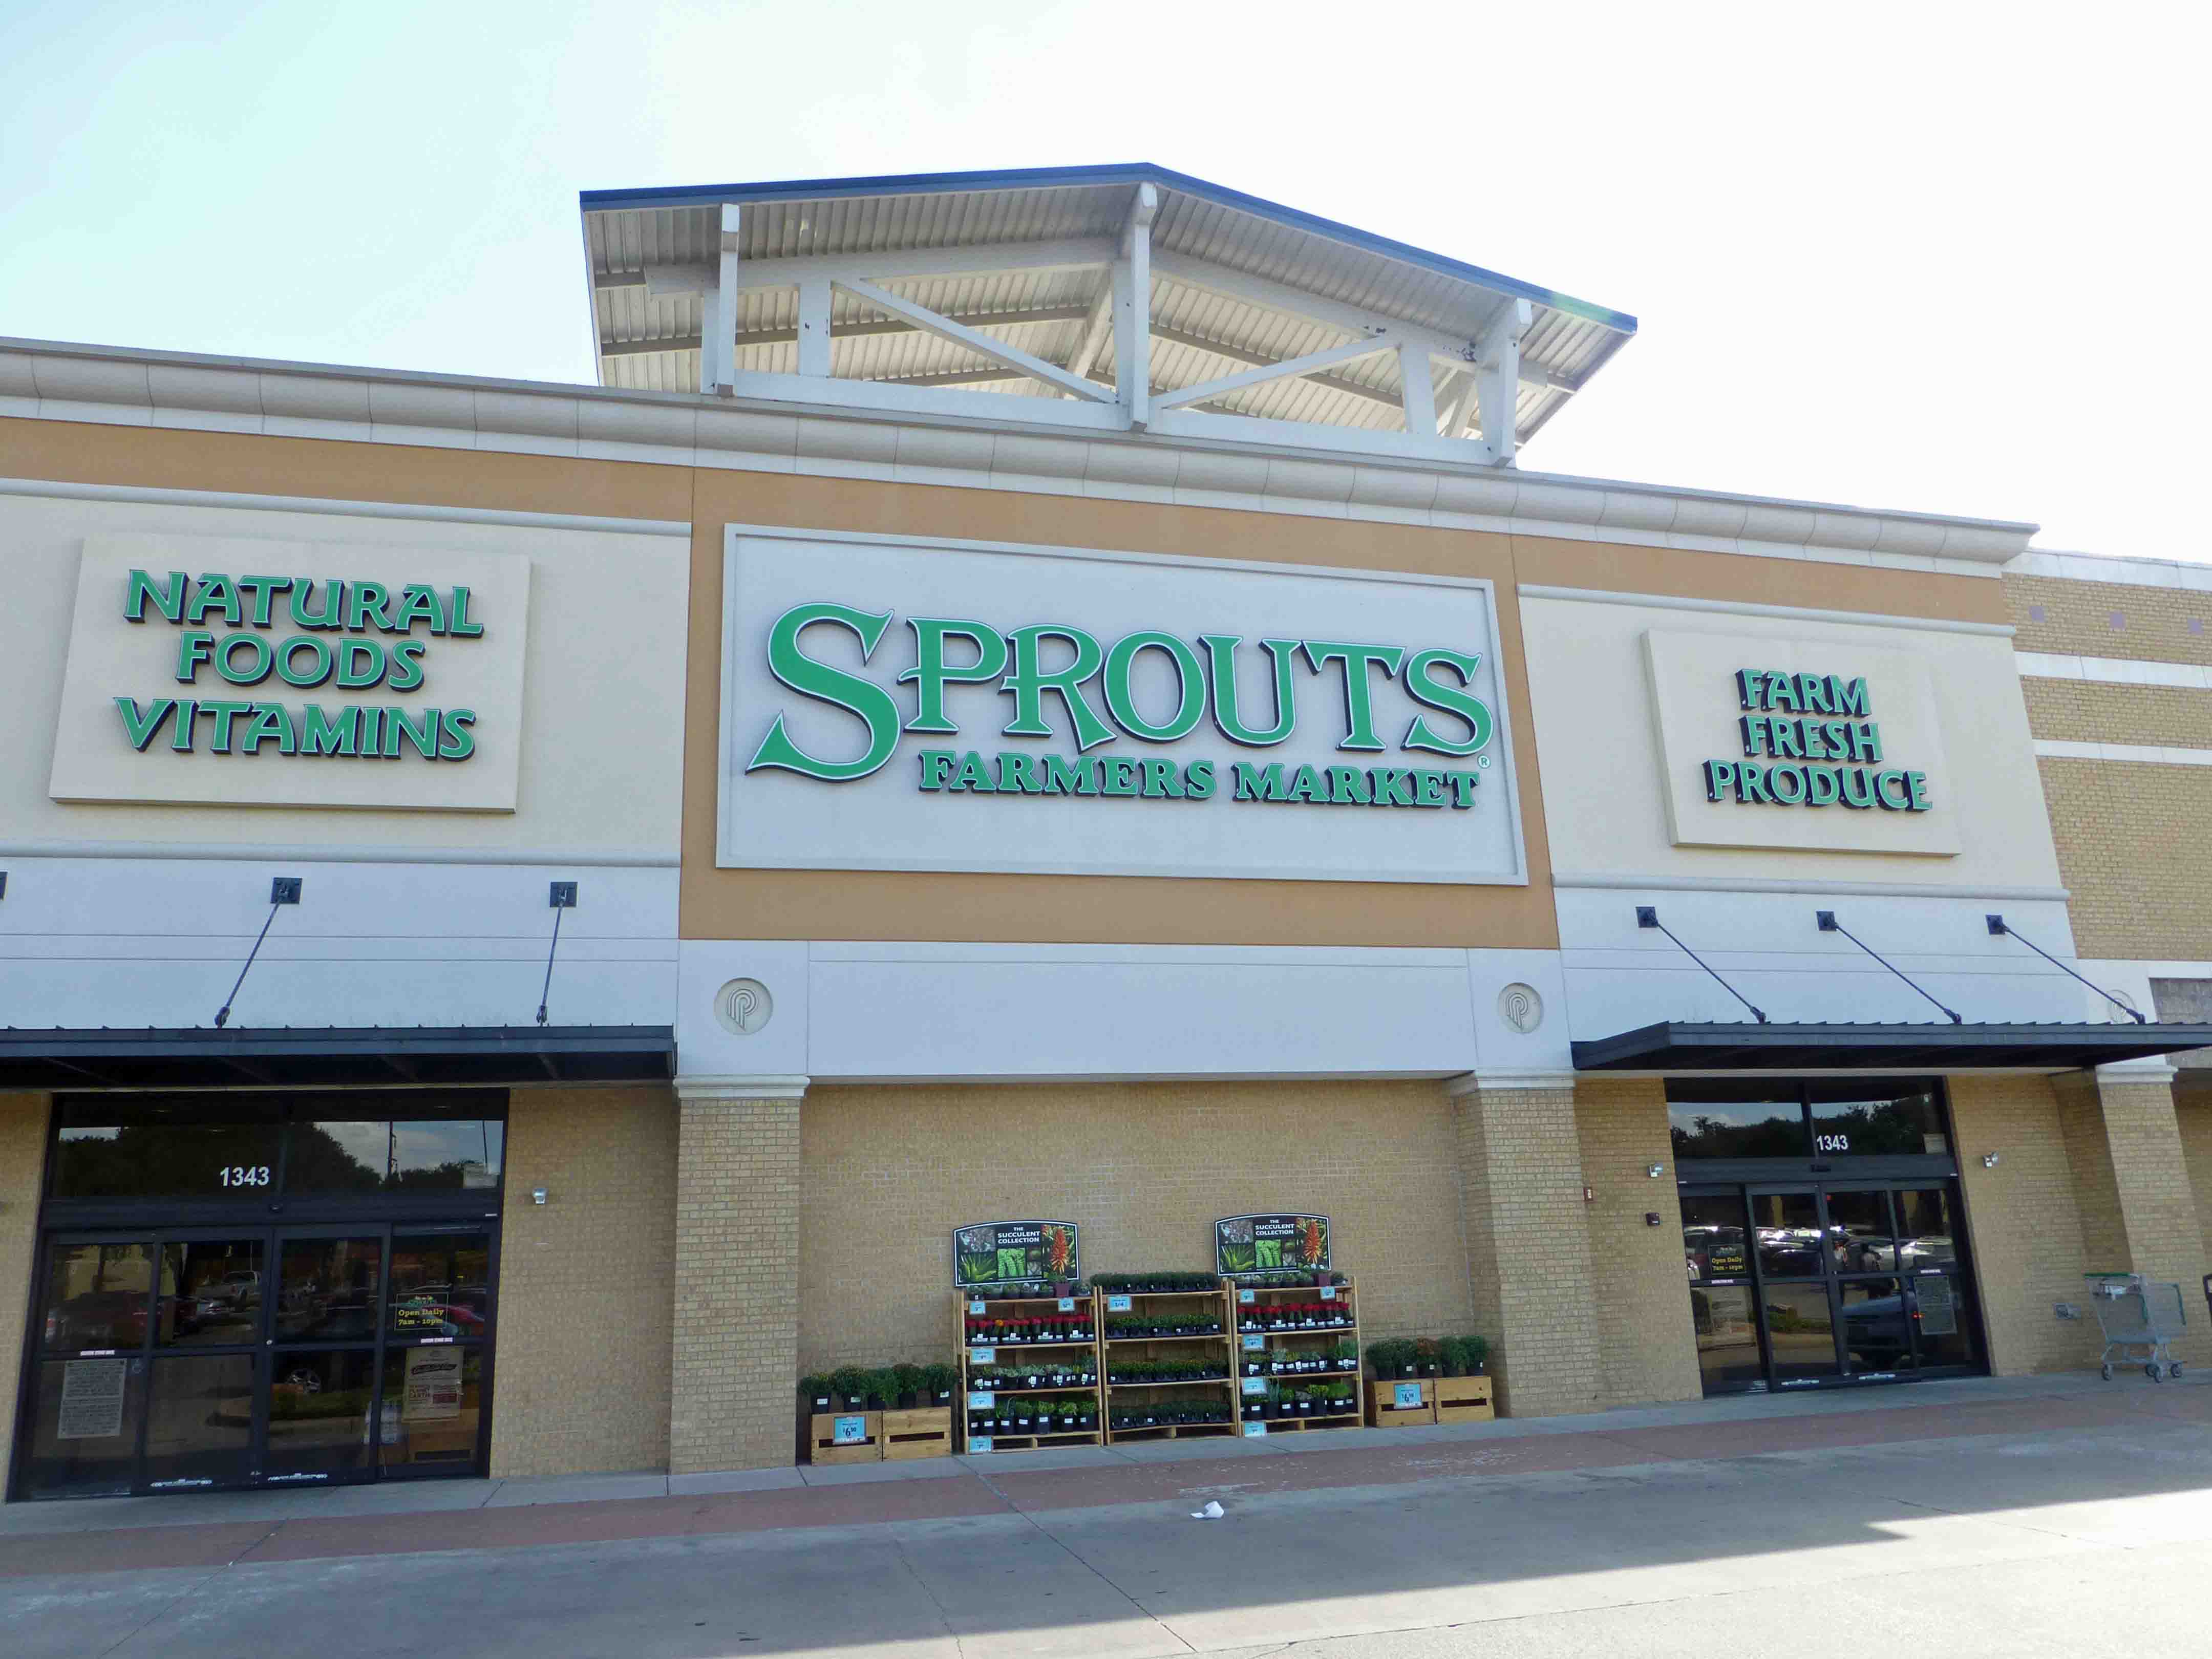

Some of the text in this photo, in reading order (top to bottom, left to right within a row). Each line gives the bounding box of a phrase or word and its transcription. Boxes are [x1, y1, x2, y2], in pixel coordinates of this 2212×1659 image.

[124, 569, 484, 638] NATURAL
[176, 630, 426, 692] FOODS
[745, 602, 1494, 783] SPROUTS
[1735, 668, 1872, 718] FARM
[113, 697, 476, 762] VITAMINS
[1738, 715, 1884, 764] FRESH
[918, 750, 1480, 810] FARMERS MARKET
[1701, 759, 1933, 812] PRODUCE
[1816, 1135, 1848, 1151] 1343
[220, 1166, 269, 1186] 1343
[398, 1309, 420, 1317] Open
